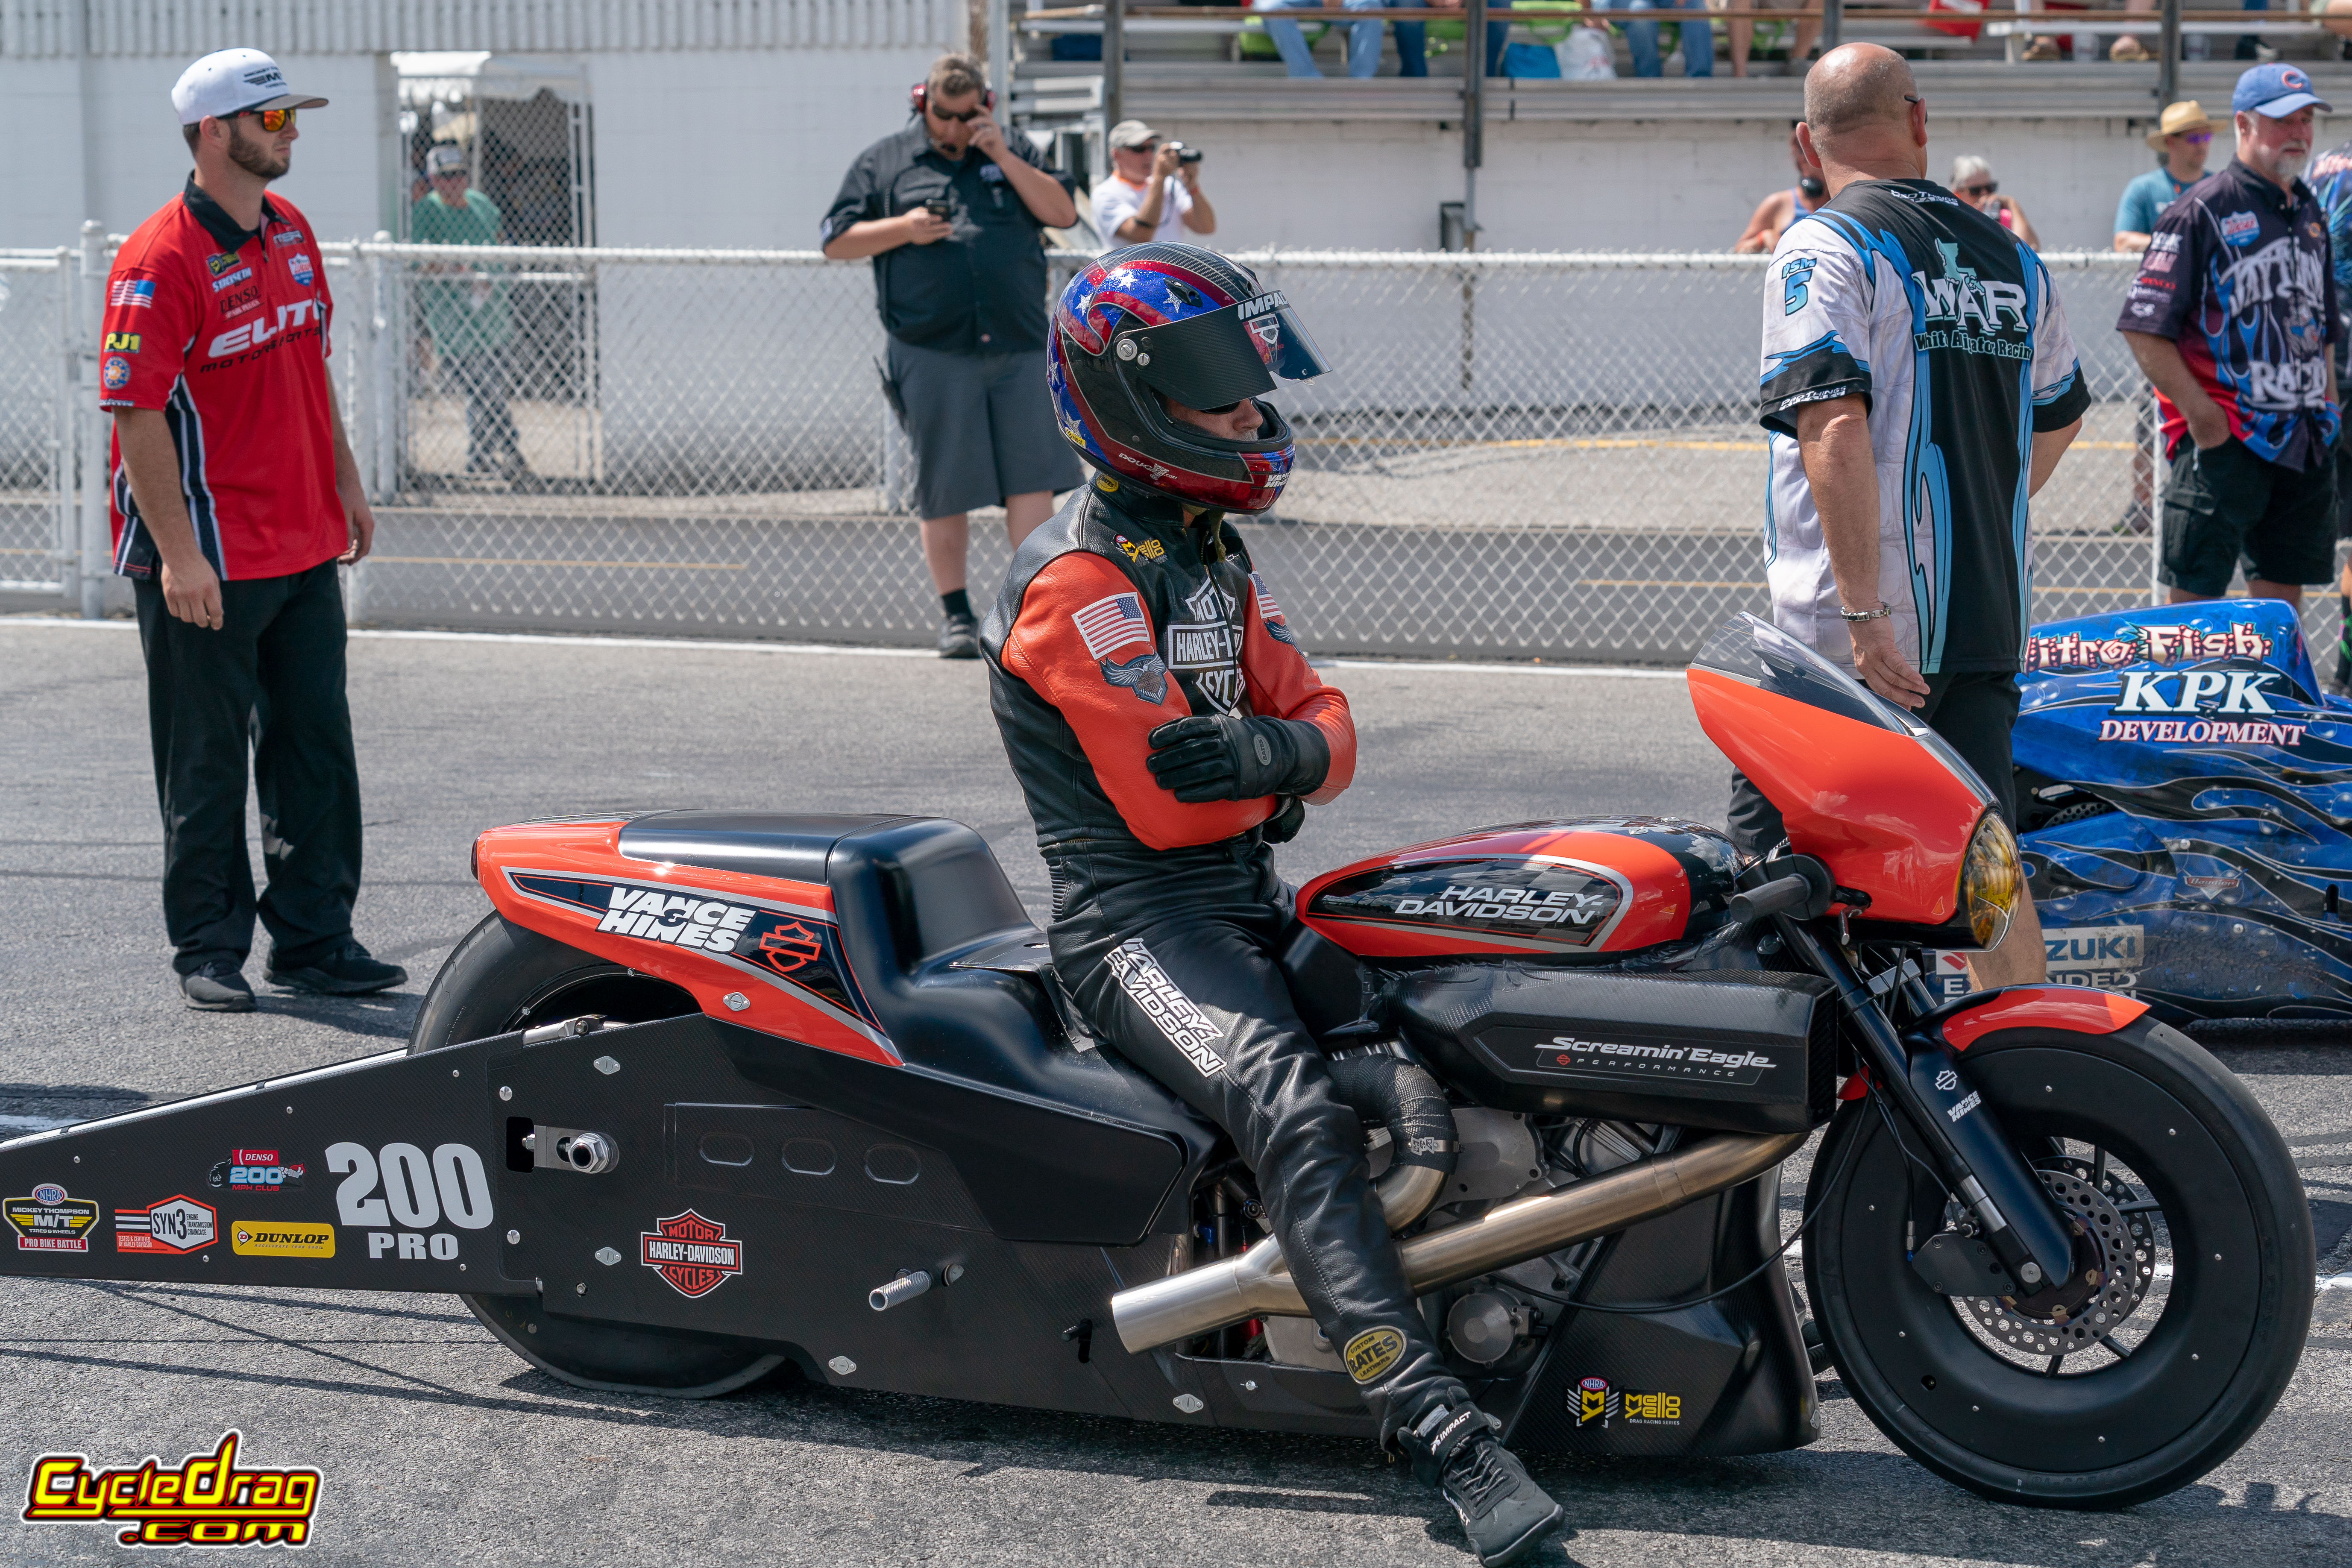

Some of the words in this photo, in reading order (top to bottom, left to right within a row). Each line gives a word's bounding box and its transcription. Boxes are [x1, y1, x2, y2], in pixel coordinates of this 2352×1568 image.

[1784, 268, 1813, 317] 5
[1911, 270, 2029, 337] WAR
[104, 333, 139, 350] PJ1
[2112, 671, 2281, 715] KPK
[2098, 720, 2306, 746] DEVELOPMENT
[608, 886, 757, 931] VANCE
[1439, 885, 1604, 909] HARLEY-
[1394, 900, 1596, 924] DAVIDSON
[597, 909, 741, 953] HINES
[1576, 1058, 1735, 1077] PERFORMANCE
[1688, 1048, 1777, 1068] Eagle
[1947, 1090, 1979, 1117] VANCE
[1951, 1097, 1981, 1123] HINES
[229, 1166, 284, 1184] 200
[325, 1142, 494, 1229] 200
[40, 1189, 62, 1201] NHRA
[33, 1214, 73, 1228] M/T
[152, 1208, 187, 1240] SYN3
[669, 1219, 714, 1240] MOTOR
[24, 1238, 38, 1248] PRO
[40, 1239, 56, 1248] BIKE
[56, 1239, 82, 1249] BATTLE
[254, 1232, 330, 1244] DUNLOP
[368, 1232, 459, 1260] PRO
[649, 1241, 734, 1265] HARLEY-DAVIDSON
[669, 1266, 714, 1290] CYCLES
[1348, 1334, 1398, 1375] BATES
[1350, 1335, 1375, 1354] CUSTOM
[1360, 1356, 1390, 1377] LEATHERS
[1584, 1380, 1603, 1388] NHRA
[1439, 1411, 1471, 1442] IMPACT
